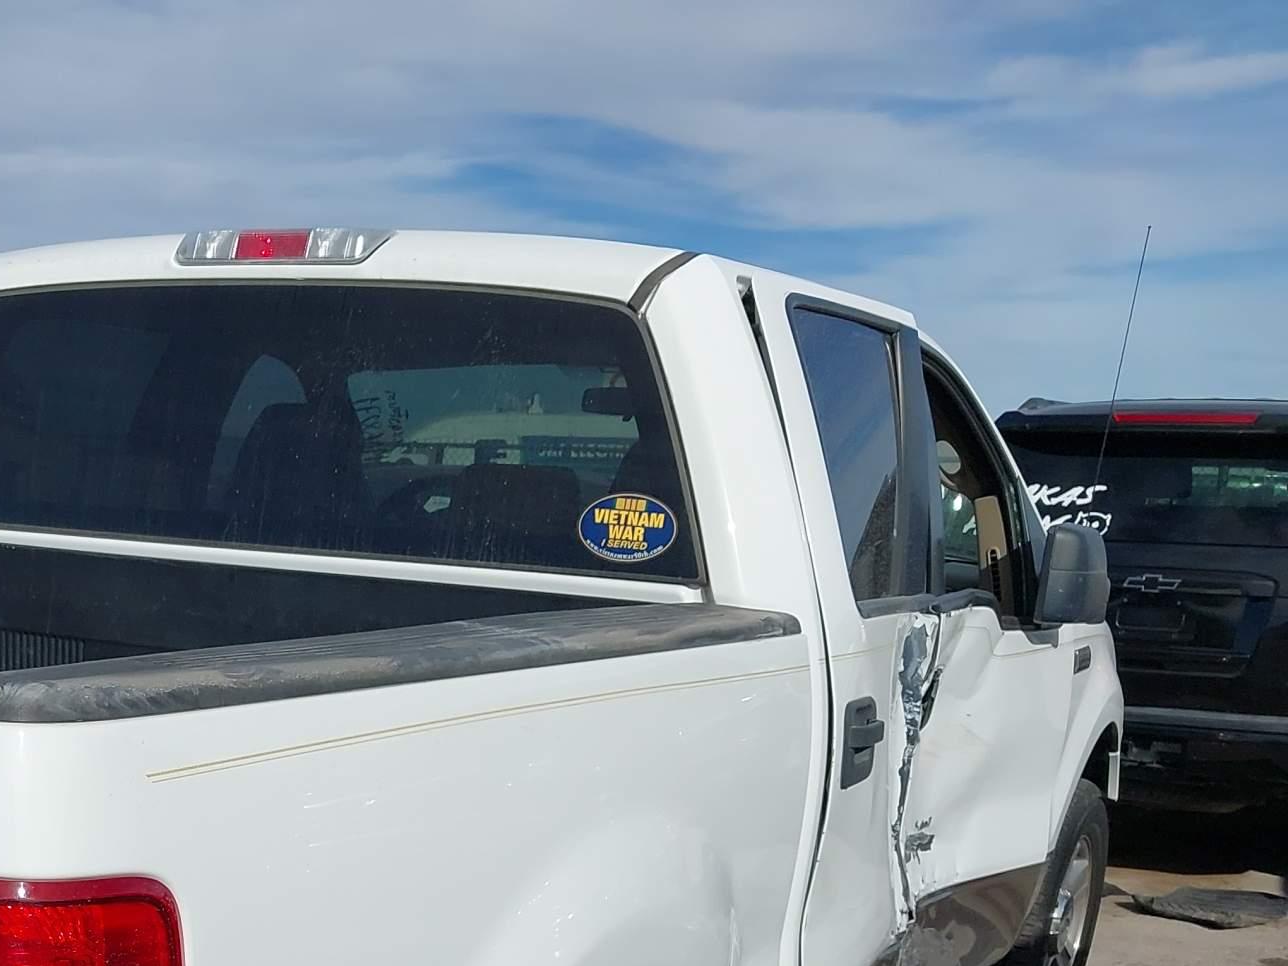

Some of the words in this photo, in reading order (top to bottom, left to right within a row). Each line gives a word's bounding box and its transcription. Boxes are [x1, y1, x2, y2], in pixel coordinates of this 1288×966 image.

[594, 508, 665, 529] VIETNAM
[608, 525, 645, 542] WAR
[600, 538, 607, 547] I
[606, 540, 649, 551] SERVED
